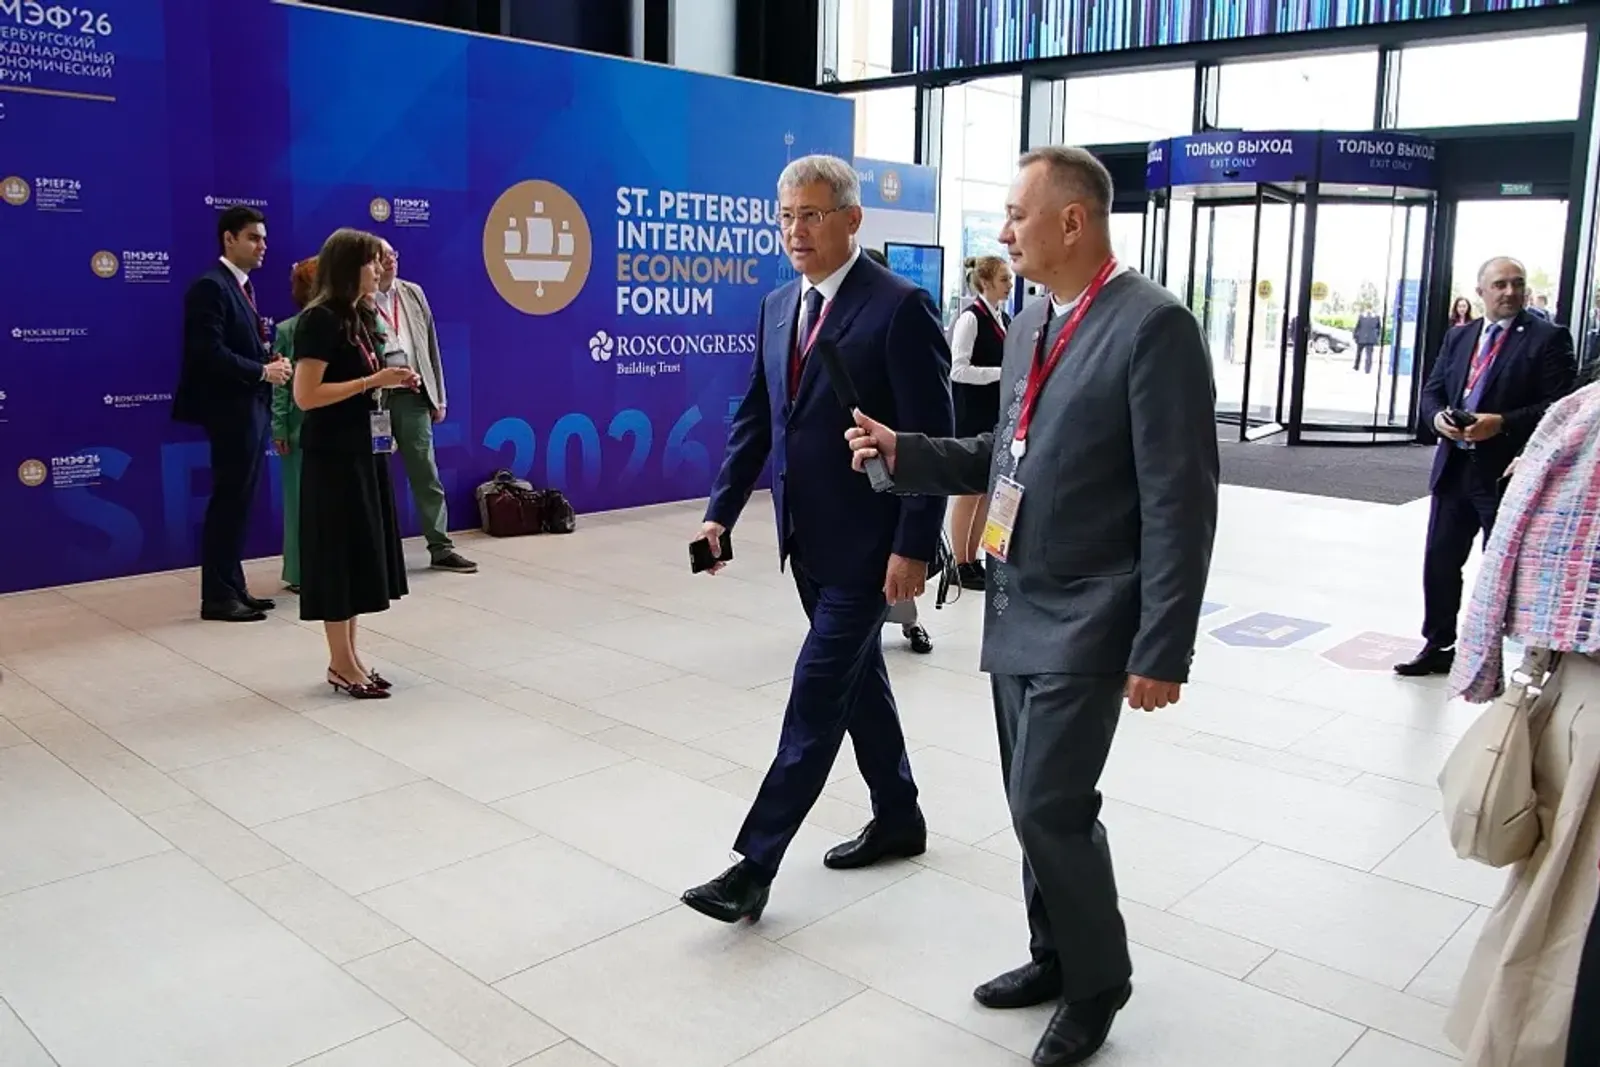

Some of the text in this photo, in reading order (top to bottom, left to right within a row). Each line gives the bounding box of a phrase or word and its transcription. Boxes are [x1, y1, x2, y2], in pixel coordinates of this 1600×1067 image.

[0, 26, 96, 49] ЕРБУРГСКИЙ
[1185, 139, 1293, 157] ТОЛЬКО ВЫХОД
[1337, 139, 1435, 161] ТОЛЬКО ВЫХОД
[1210, 157, 1257, 169] EXIT ONLY
[616, 186, 653, 217] ST.
[616, 253, 759, 285] ECONOMIC
[616, 286, 713, 316] FORUM
[616, 333, 756, 357] ROSCONGRESS
[616, 361, 681, 377] Building Trust
